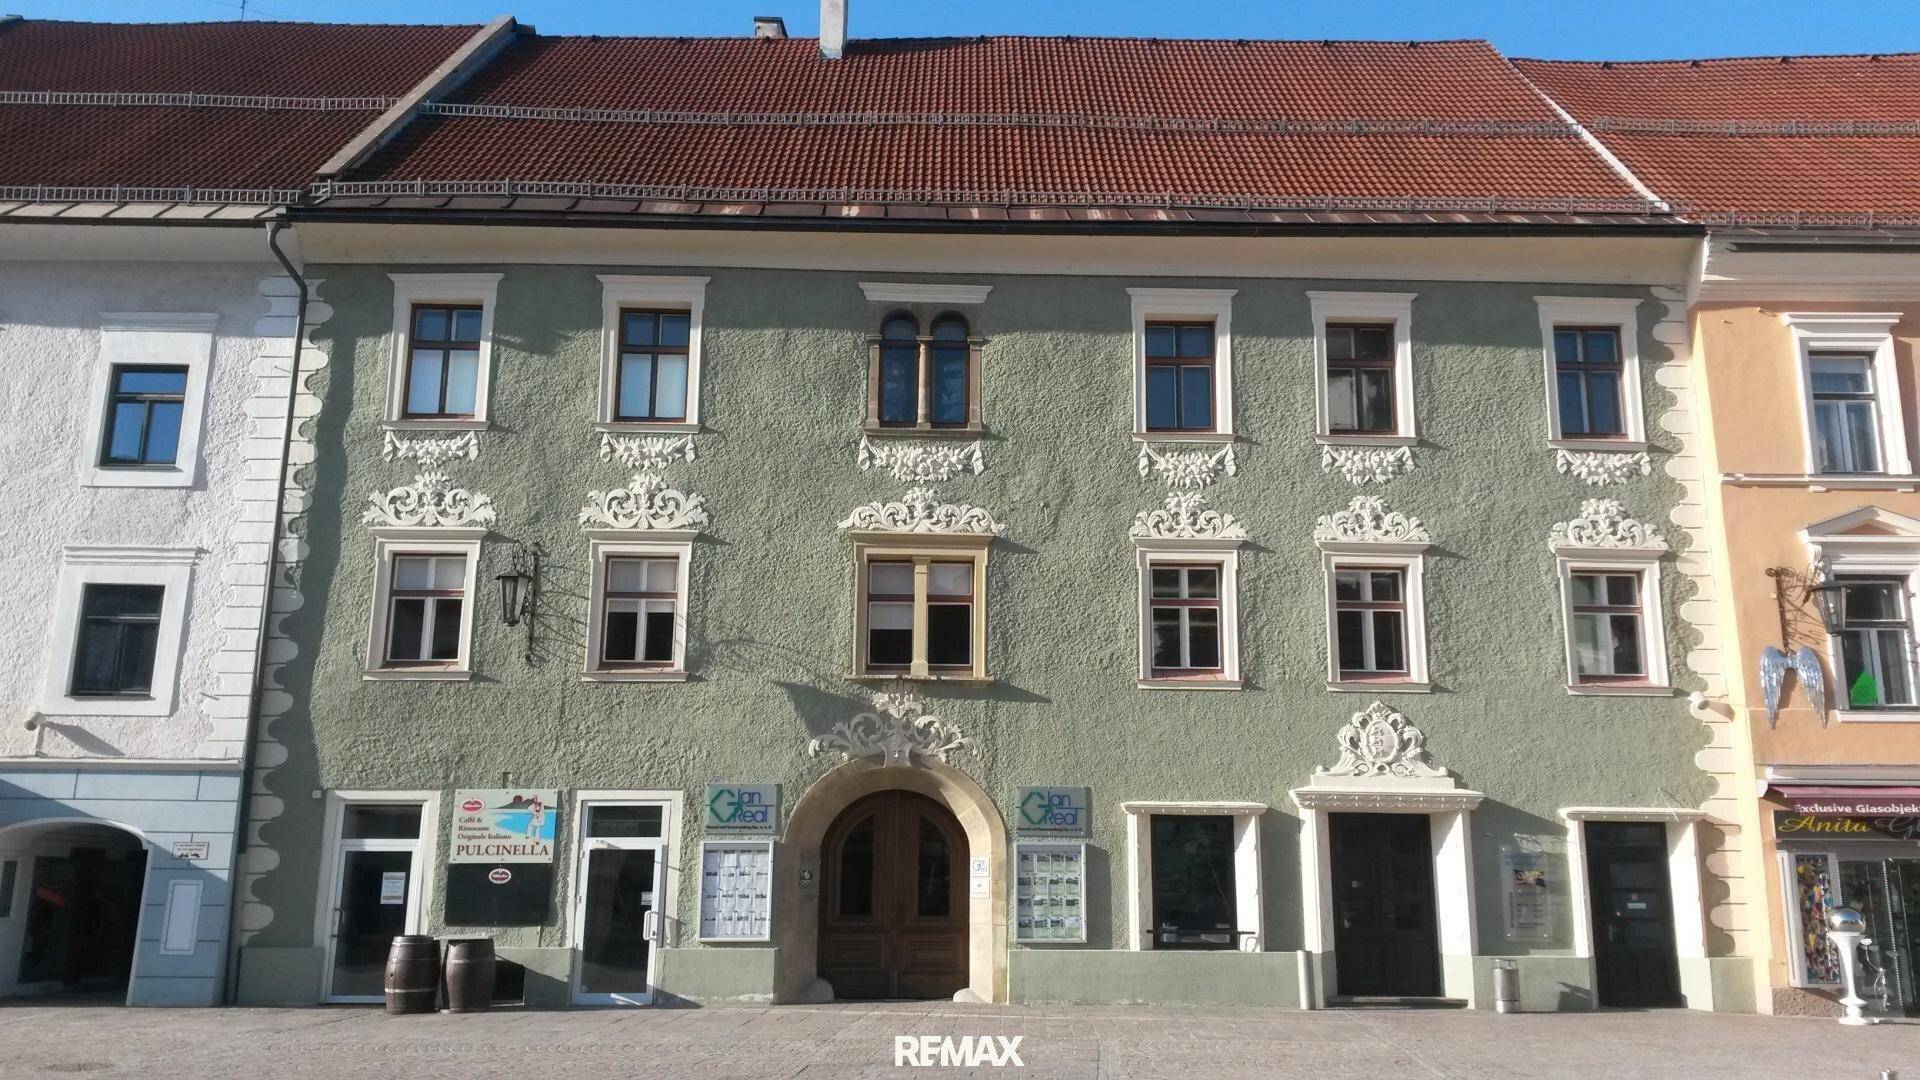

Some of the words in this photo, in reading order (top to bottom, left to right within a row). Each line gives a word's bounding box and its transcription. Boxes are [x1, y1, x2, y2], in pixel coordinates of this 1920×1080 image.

[732, 805, 768, 823] Real
[1795, 803, 1852, 813] Exclusive
[1856, 803, 1920, 815] Glasobjek
[1044, 807, 1078, 825] Real
[1778, 815, 1871, 832] Anita
[458, 833, 486, 841] Originale
[457, 845, 548, 856] PULCINELLA
[804, 870, 810, 880] 6
